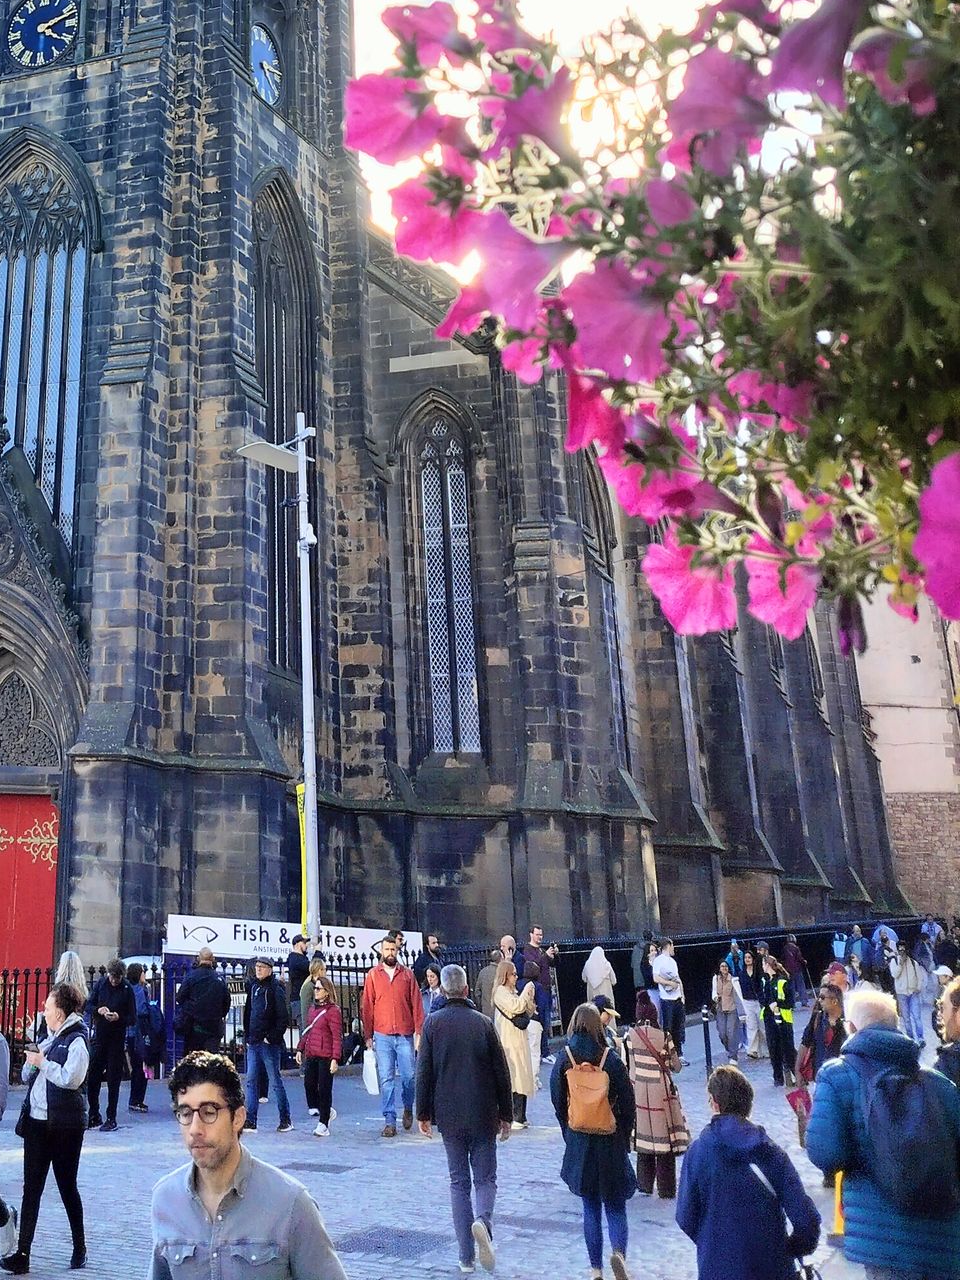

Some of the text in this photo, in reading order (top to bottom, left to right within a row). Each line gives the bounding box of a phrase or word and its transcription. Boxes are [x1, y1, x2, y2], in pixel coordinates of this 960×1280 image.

[233, 923, 270, 942] Fish
[279, 927, 291, 944] &
[318, 929, 357, 950] ites
